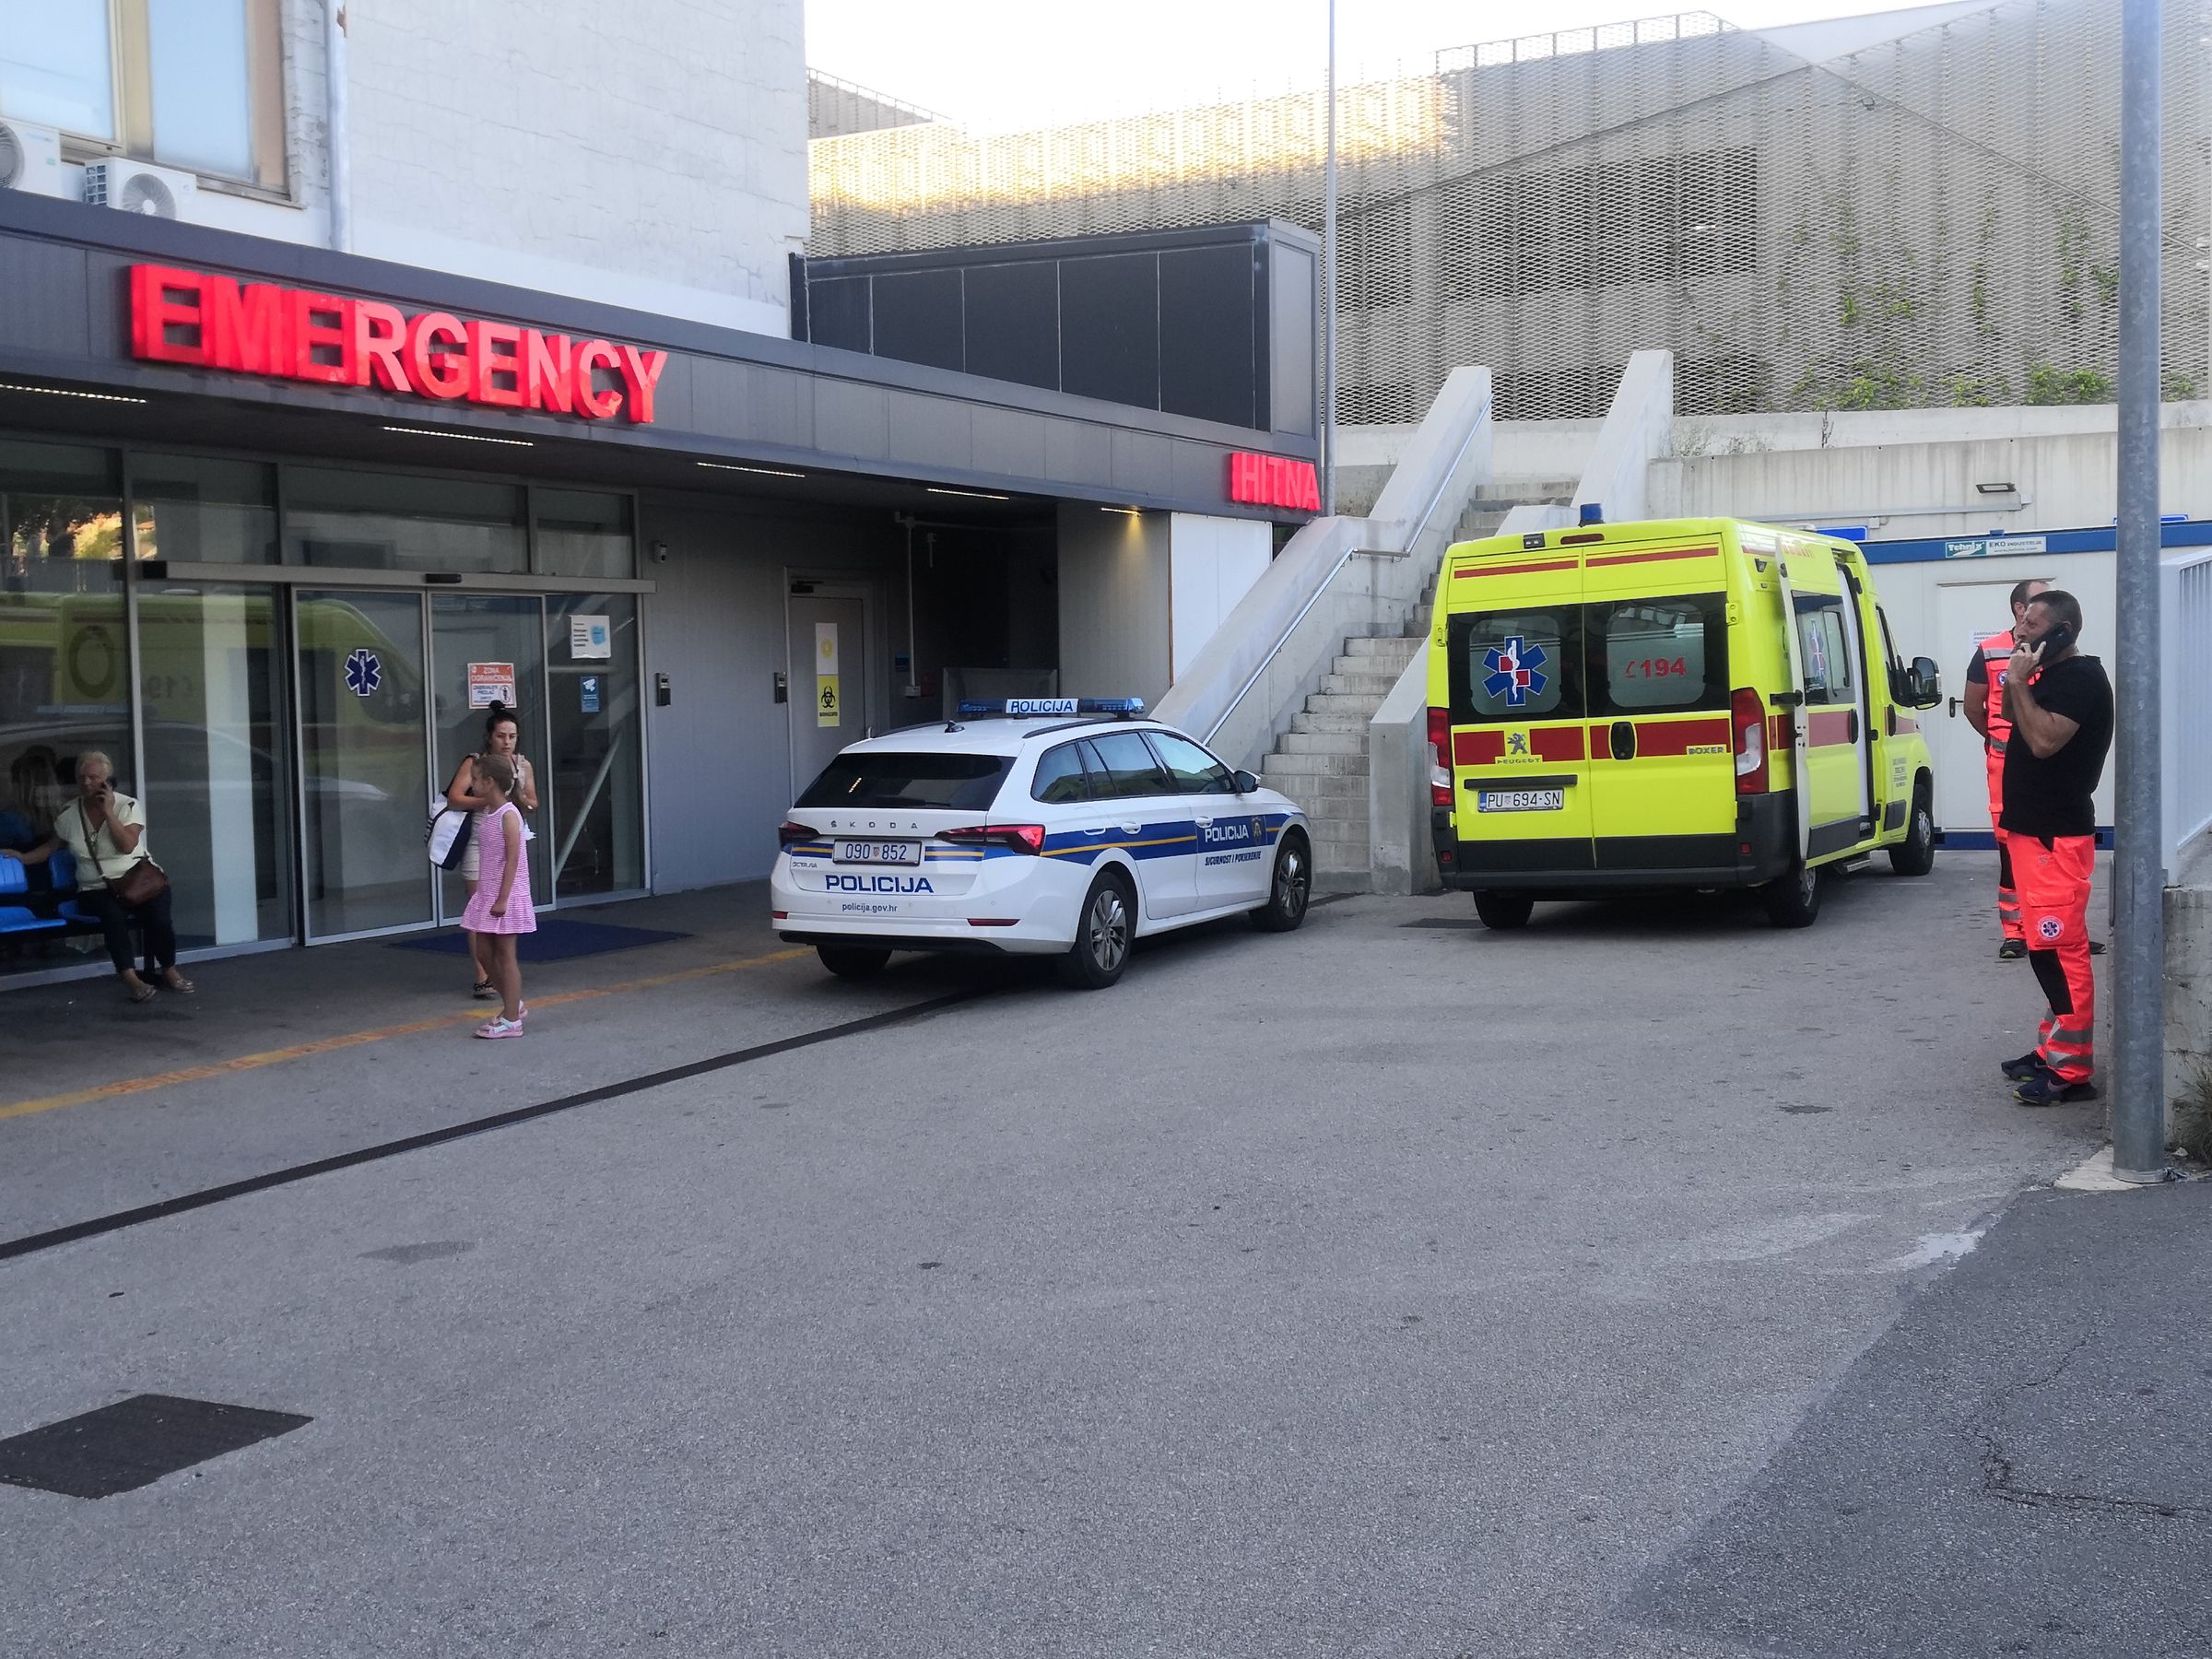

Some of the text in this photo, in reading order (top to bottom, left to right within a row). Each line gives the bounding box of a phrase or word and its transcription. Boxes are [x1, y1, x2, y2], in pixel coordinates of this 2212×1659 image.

[131, 264, 668, 424] EMERGENCY
[1231, 452, 1322, 512] HITNA
[1641, 657, 1687, 679] 194
[1010, 700, 1074, 712] POLICIJA
[1688, 747, 1724, 755] BOXER
[1488, 794, 1504, 808] PU
[1205, 824, 1249, 842] POLICIJA
[845, 843, 908, 861] 090 852
[1205, 853, 1232, 866] SIGURNOST
[825, 875, 935, 894] POLICIJA
[841, 901, 899, 913] policija.gov.hr
